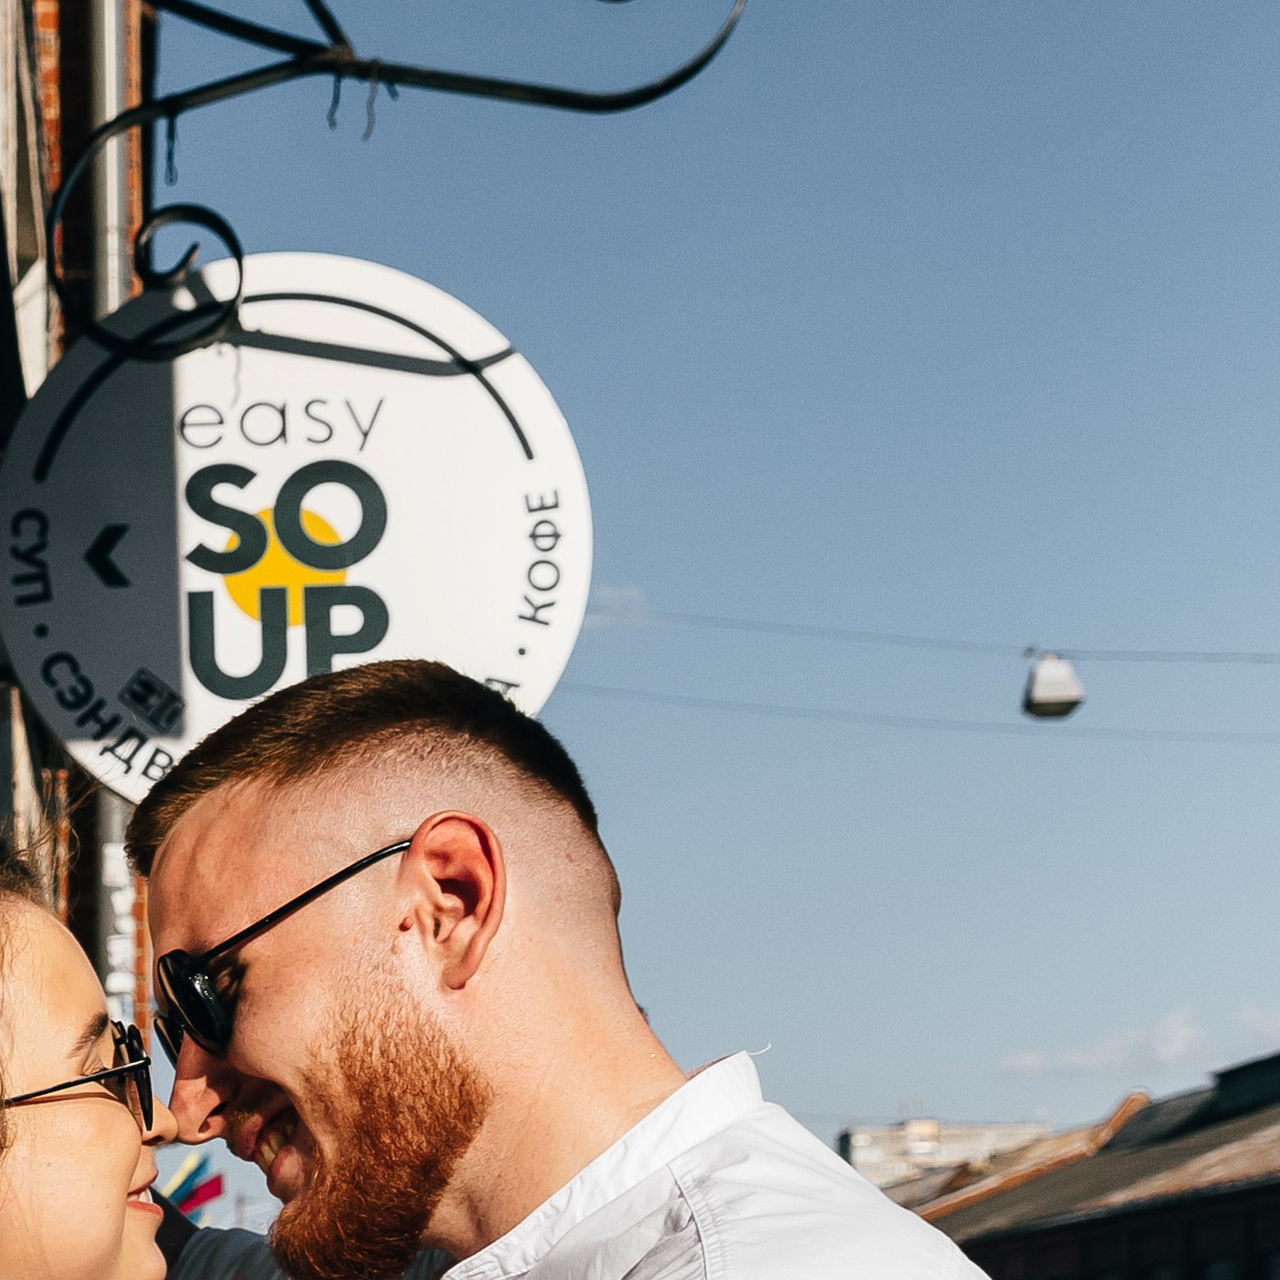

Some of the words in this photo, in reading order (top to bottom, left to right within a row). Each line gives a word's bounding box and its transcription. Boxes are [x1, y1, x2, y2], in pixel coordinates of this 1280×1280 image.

[179, 398, 384, 453] easy
[184, 459, 388, 576] SO
[9, 507, 53, 608] СУП
[40, 650, 174, 782] СЭНДВ
[517, 490, 562, 627] КОФЕ
[187, 584, 389, 701] UP
